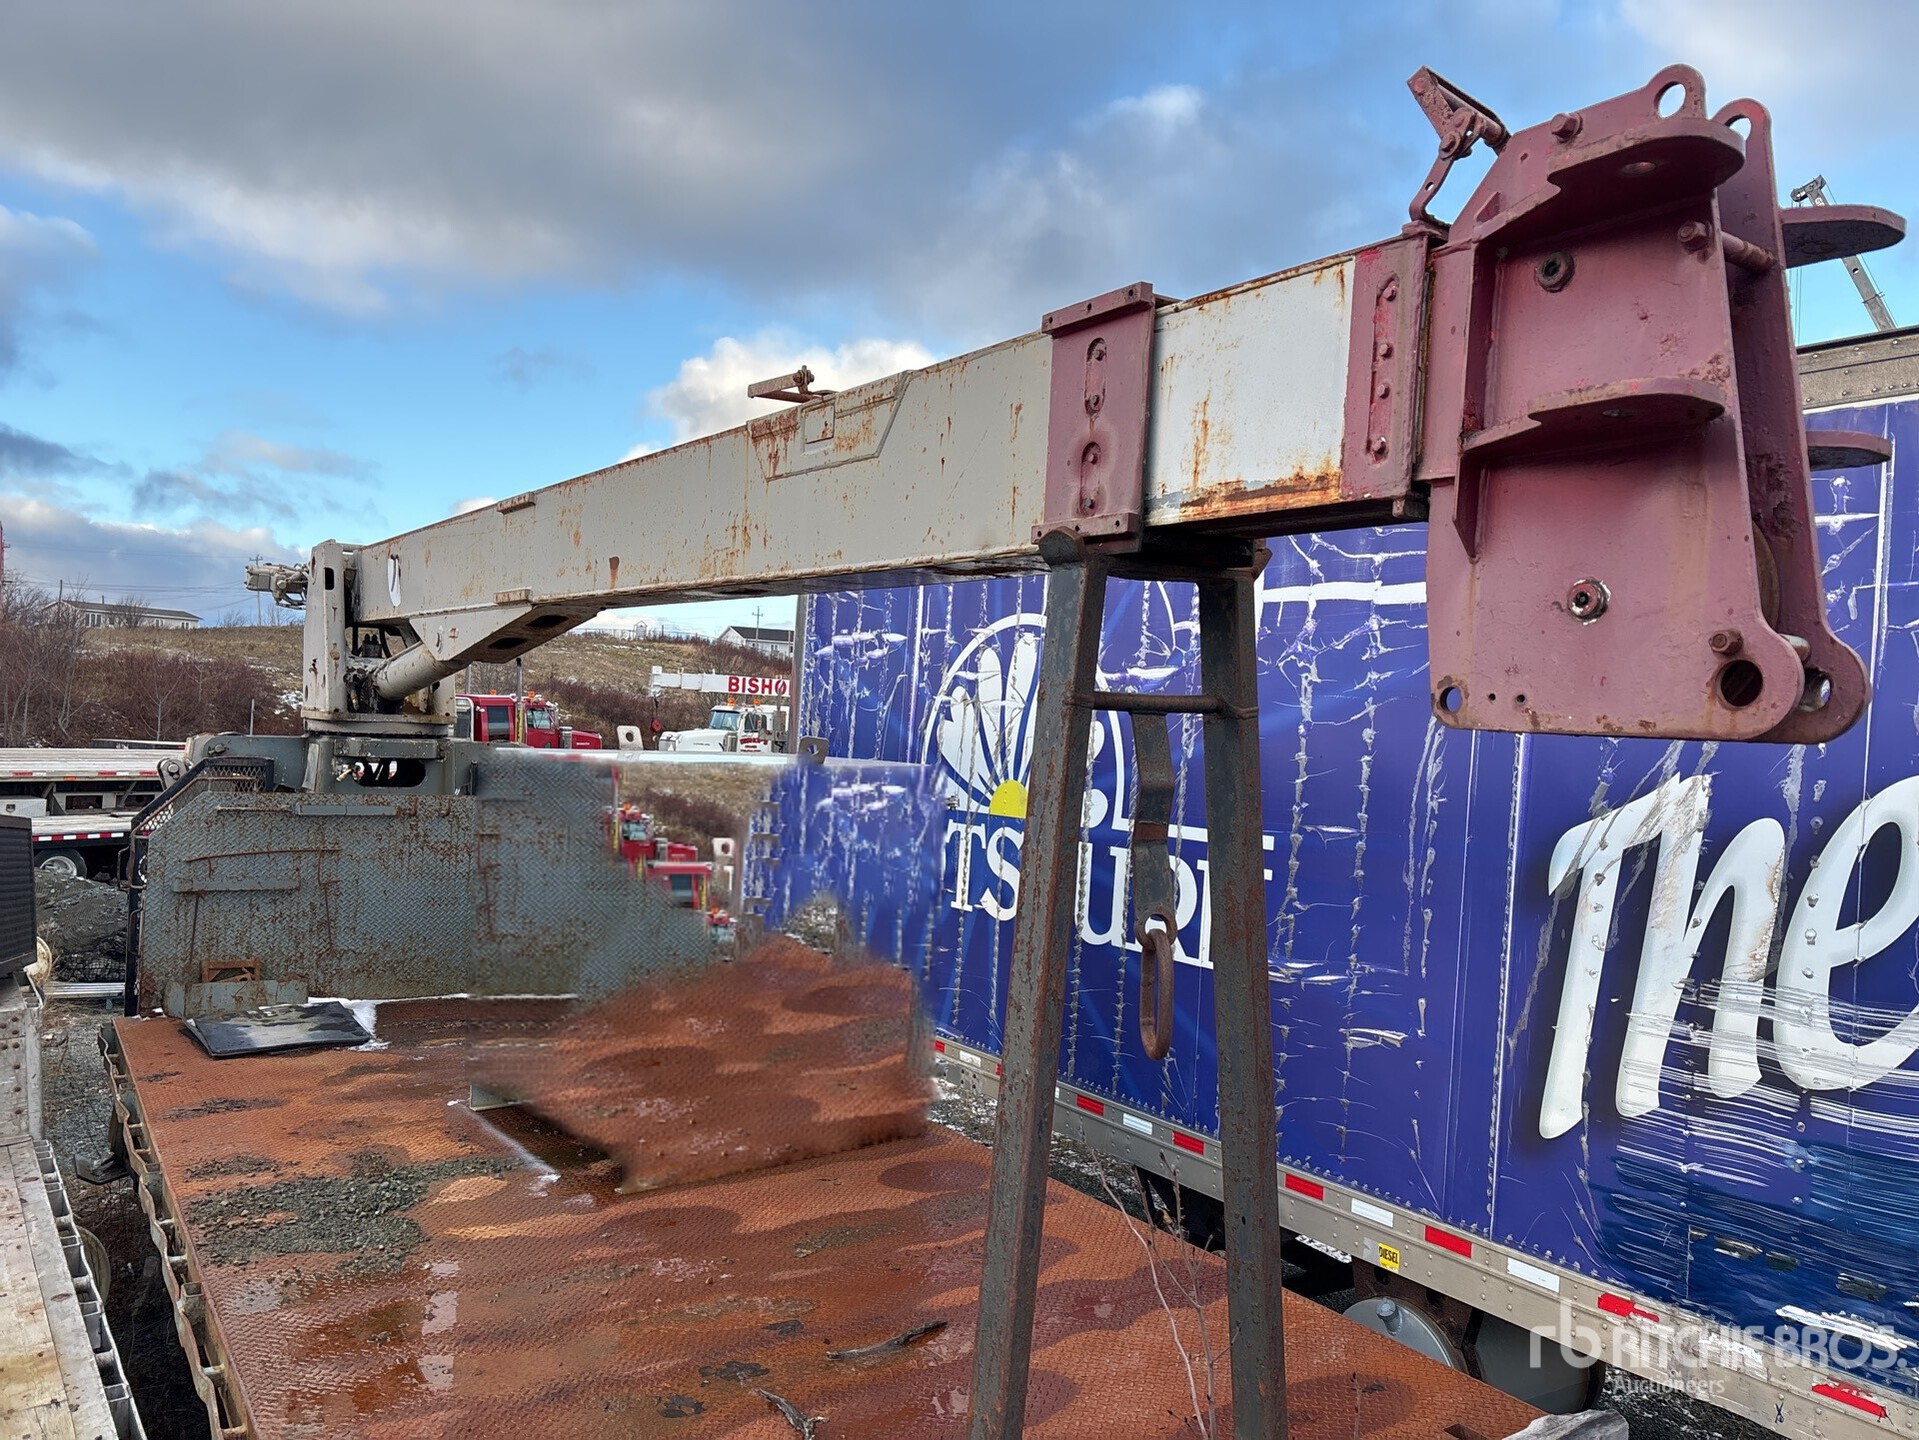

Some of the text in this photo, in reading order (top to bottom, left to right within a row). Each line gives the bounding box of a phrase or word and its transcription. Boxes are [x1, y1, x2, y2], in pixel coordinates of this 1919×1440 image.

[728, 676, 787, 695] BISHO
[1538, 771, 1919, 1139] The
[1379, 1246, 1398, 1264] DIESEL
